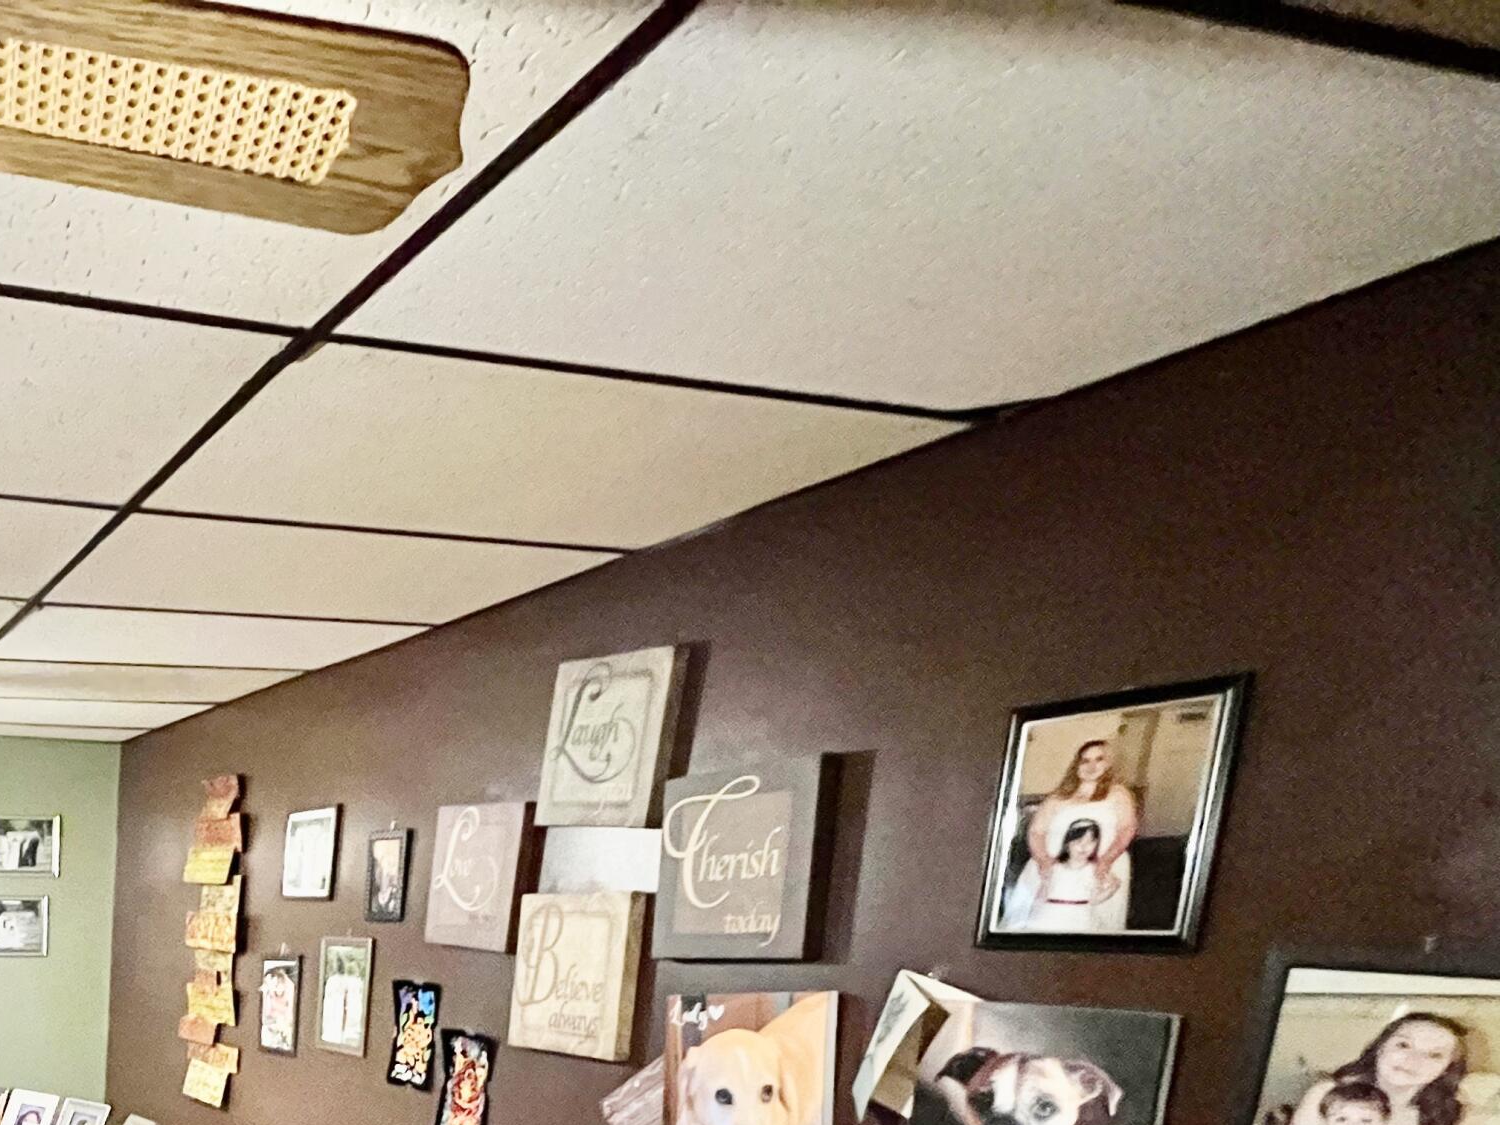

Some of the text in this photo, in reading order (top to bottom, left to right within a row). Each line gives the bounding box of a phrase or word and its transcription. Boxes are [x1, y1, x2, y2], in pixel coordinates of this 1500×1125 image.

[549, 661, 636, 784] Laugh
[433, 805, 499, 912] Love
[663, 774, 784, 908] Cherish
[516, 902, 605, 1008] Believe
[724, 900, 781, 947] today
[549, 1001, 599, 1044] always
